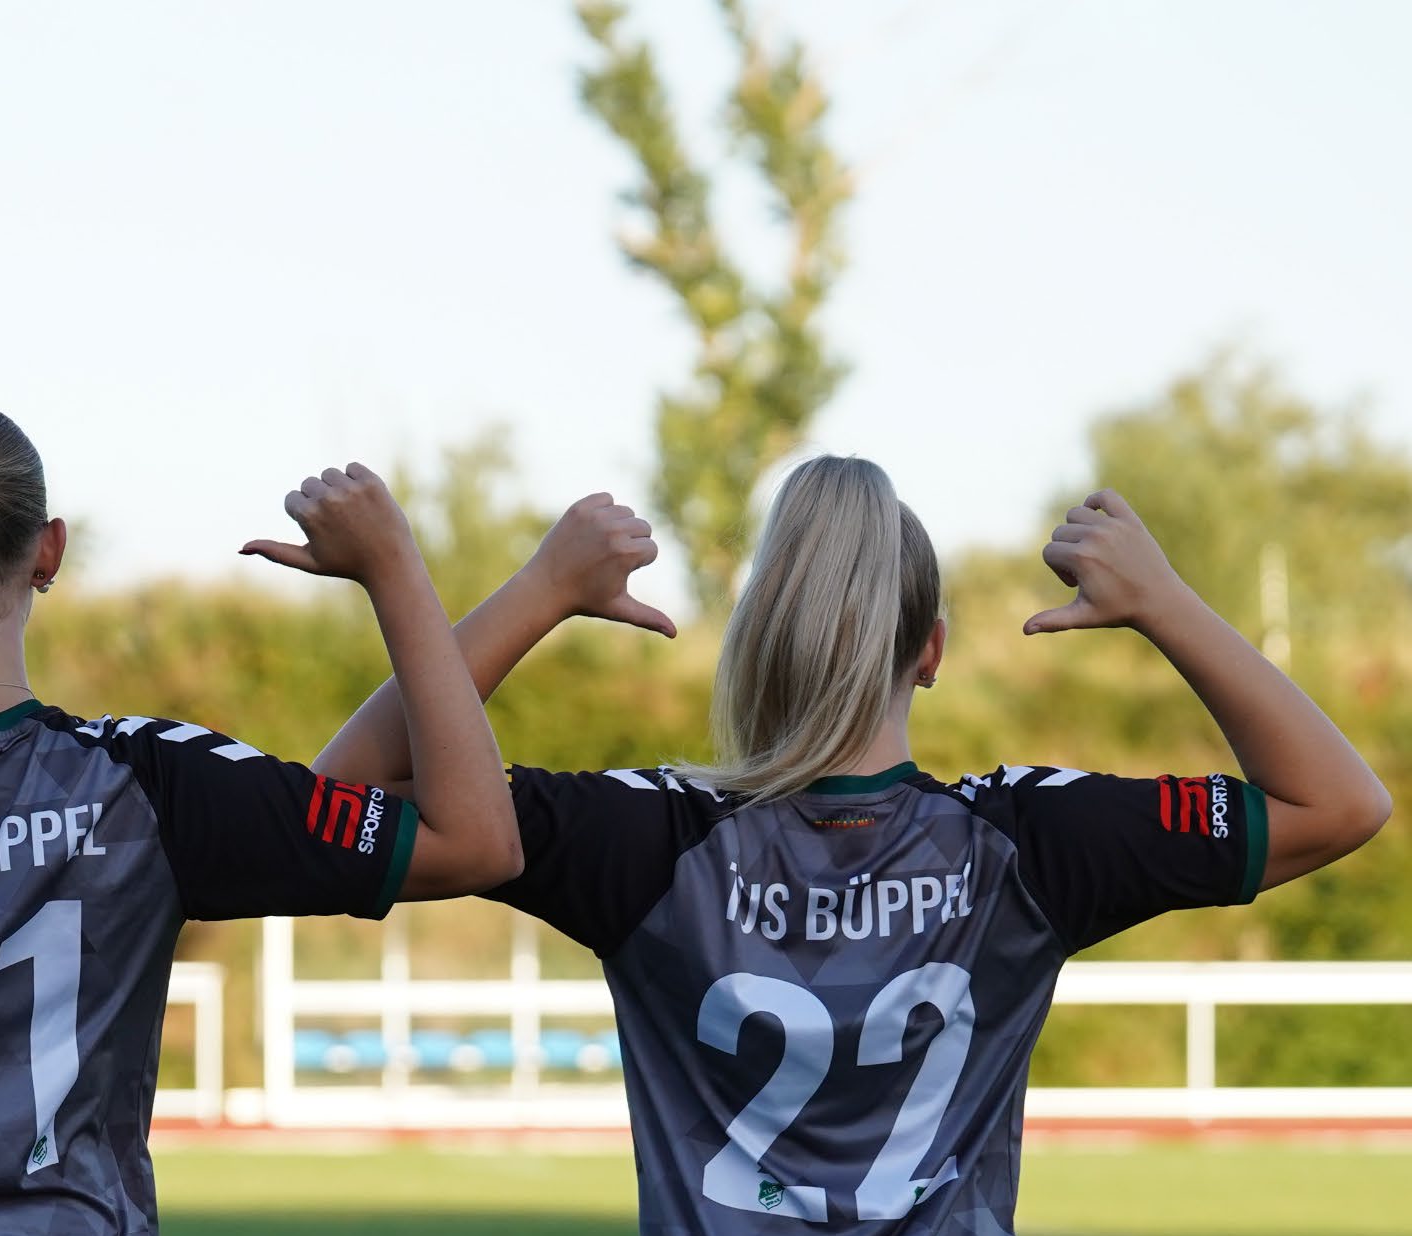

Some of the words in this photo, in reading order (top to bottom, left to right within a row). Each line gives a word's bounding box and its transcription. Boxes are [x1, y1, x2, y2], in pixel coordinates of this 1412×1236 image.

[357, 799, 384, 855] SPORT
[1211, 784, 1229, 839] SPORT
[805, 862, 975, 942] BÜPPEL
[697, 961, 976, 1223] 22
